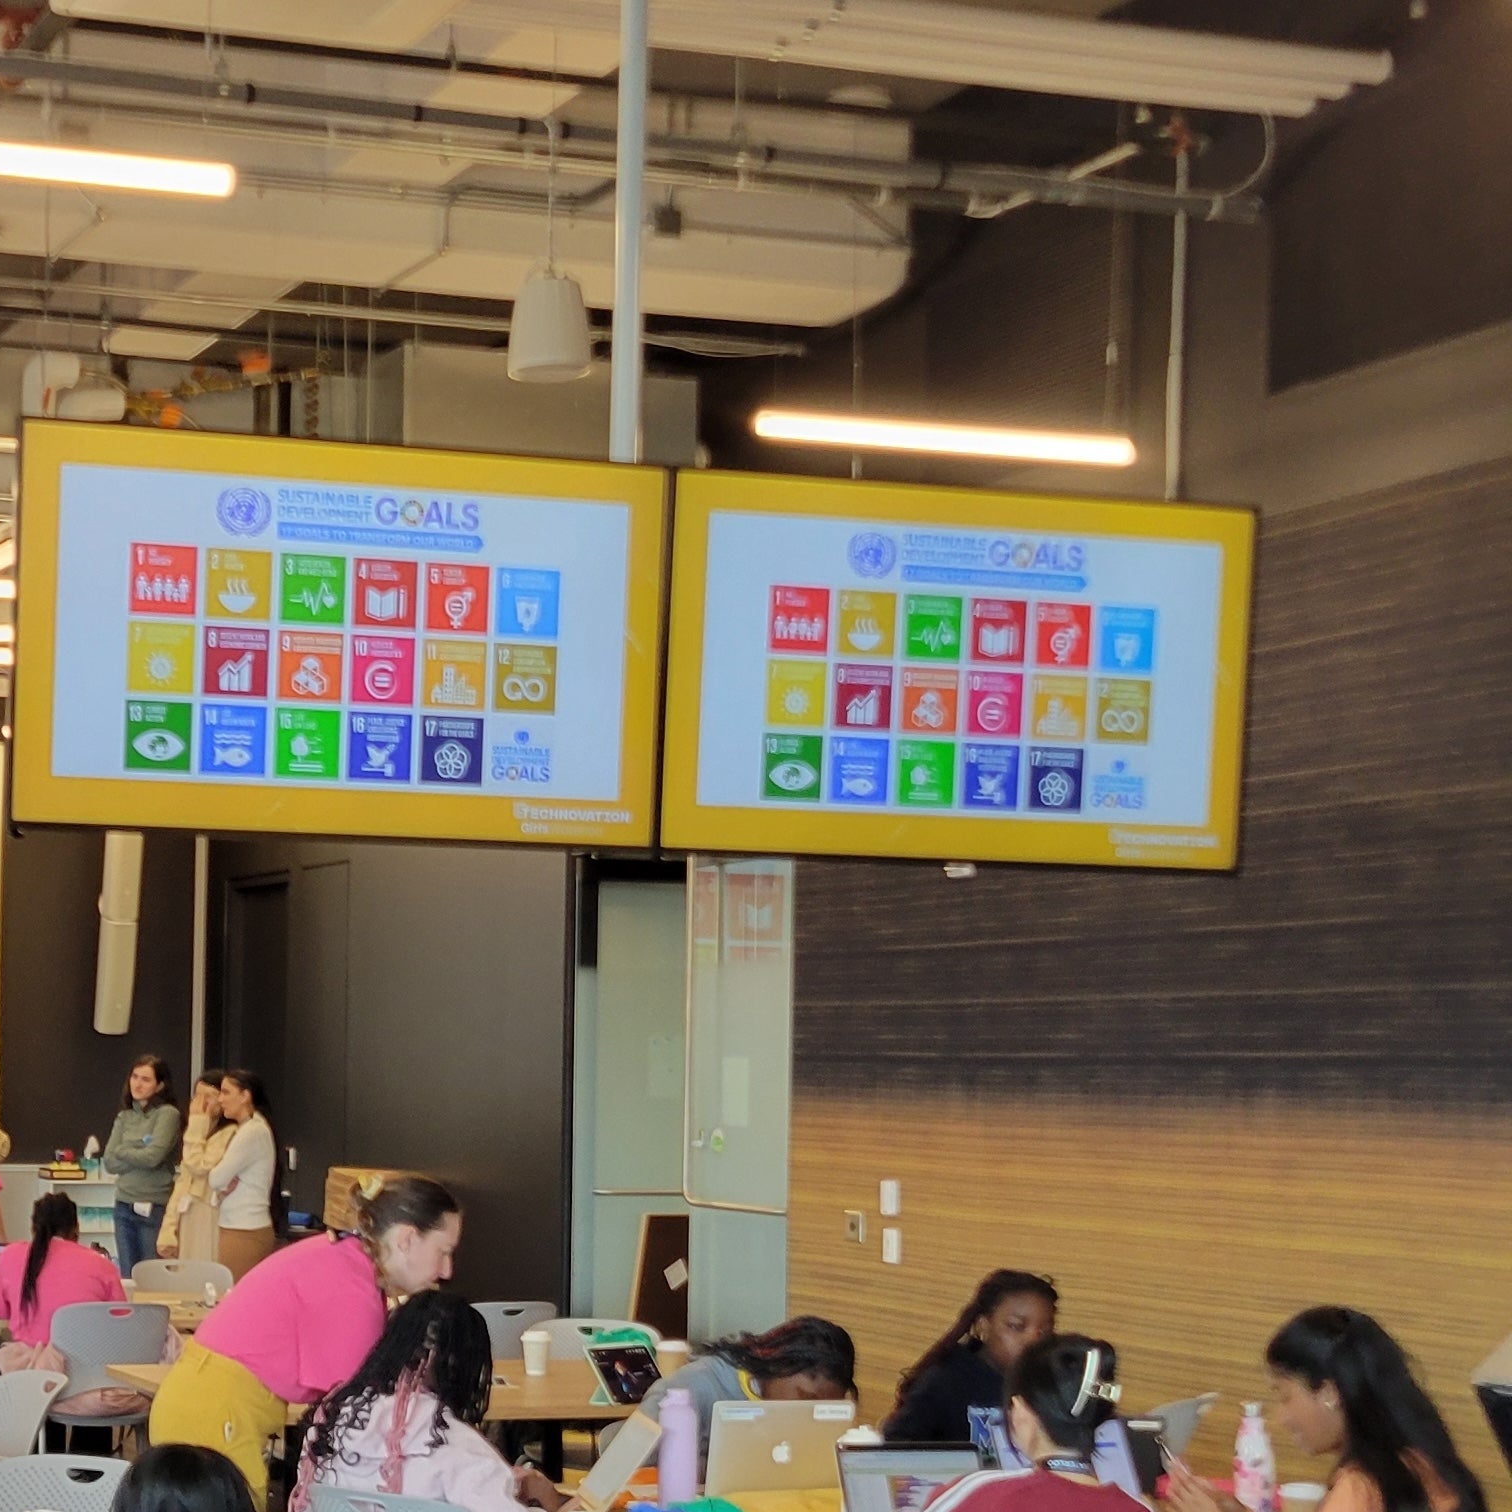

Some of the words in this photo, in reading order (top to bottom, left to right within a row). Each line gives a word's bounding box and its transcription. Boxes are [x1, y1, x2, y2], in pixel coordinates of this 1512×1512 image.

[278, 489, 372, 507] SUSTAINABLE
[278, 505, 371, 523] DEVELOPMENT
[375, 497, 480, 531] GOALS
[989, 539, 1085, 571] GOALS
[128, 705, 143, 722] 13
[351, 716, 365, 734] 16
[424, 719, 438, 737] 17
[491, 764, 551, 782] GOALS
[517, 805, 631, 824] TECHNOVATION
